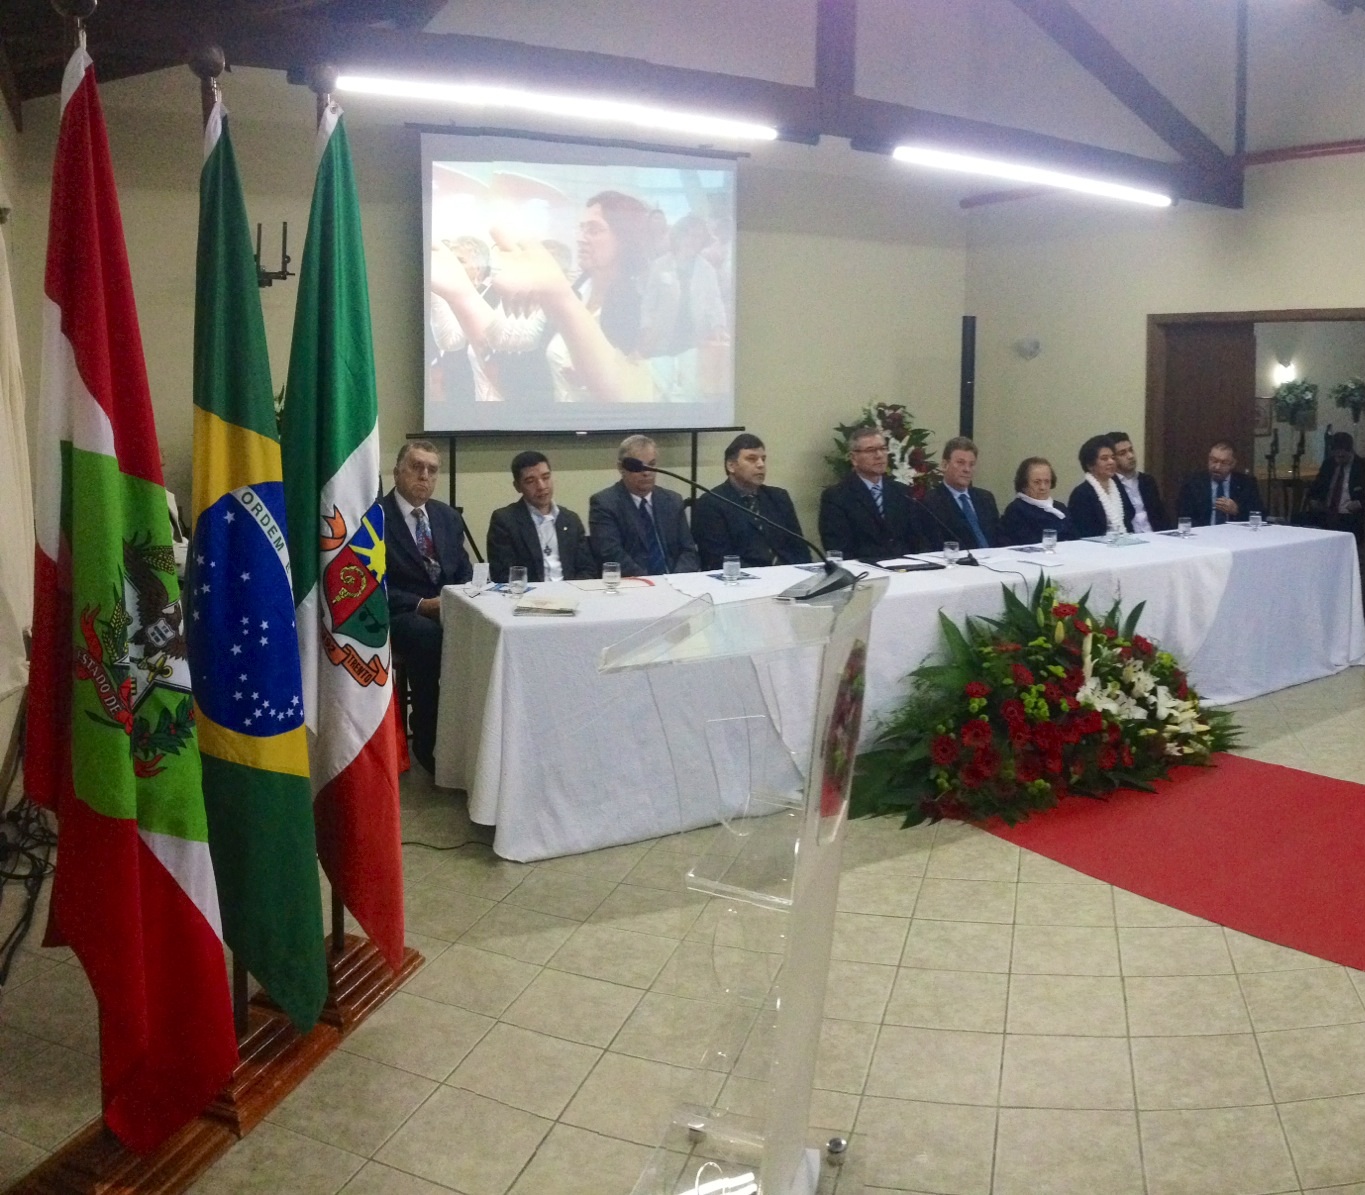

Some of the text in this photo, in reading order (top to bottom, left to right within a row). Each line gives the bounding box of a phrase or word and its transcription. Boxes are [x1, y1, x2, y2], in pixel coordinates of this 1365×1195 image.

[241, 491, 285, 552] ORDEM
[346, 655, 374, 683] TRENTO
[103, 696, 122, 715] DE
